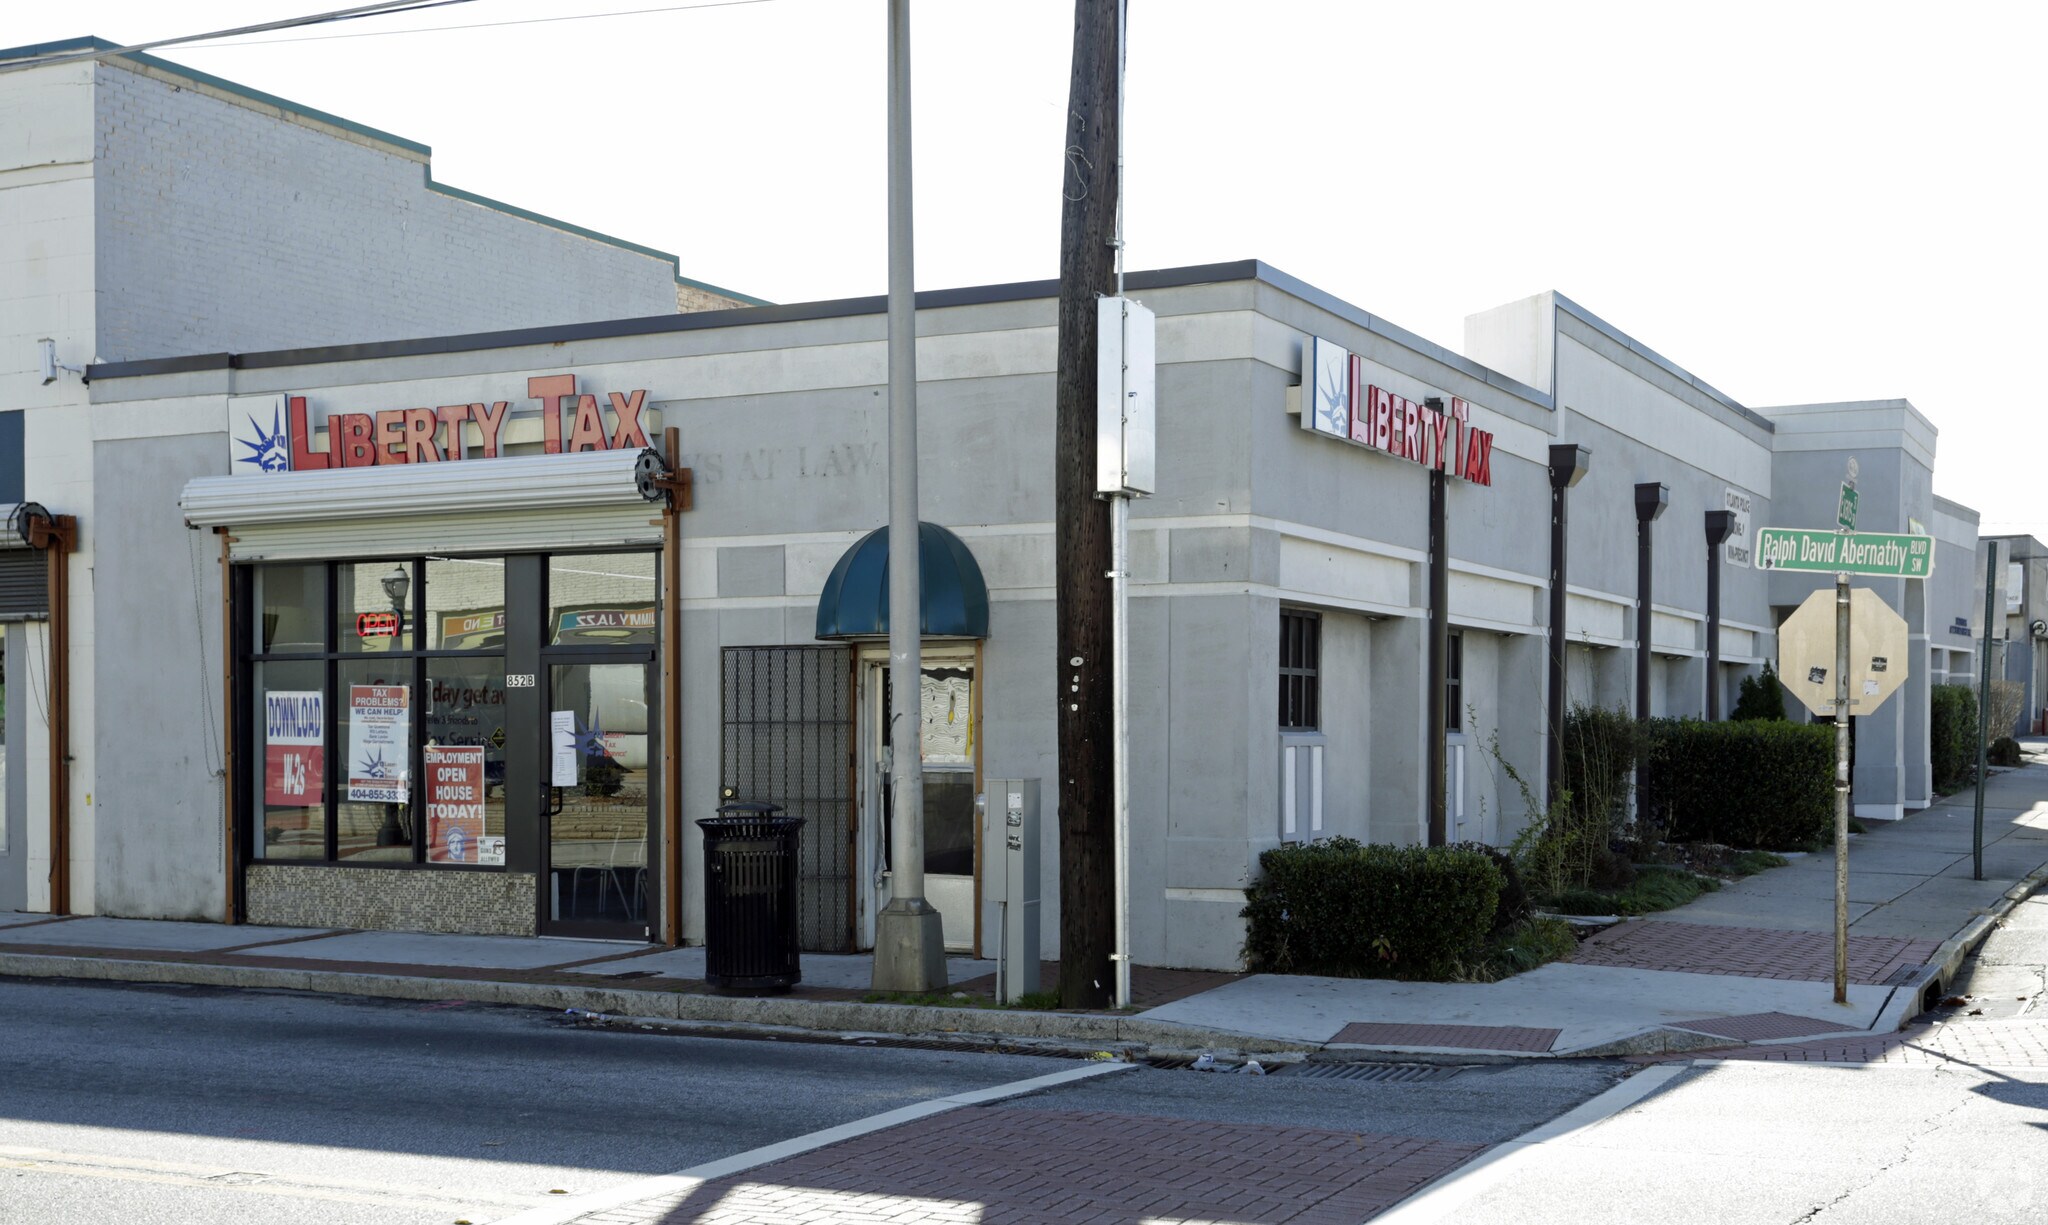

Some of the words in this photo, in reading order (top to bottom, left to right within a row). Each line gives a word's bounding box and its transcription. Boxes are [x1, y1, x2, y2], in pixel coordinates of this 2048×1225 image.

[290, 397, 510, 471] LIBERTY
[528, 374, 648, 455] TAX
[1350, 354, 1449, 470] LIBERTY
[1452, 396, 1494, 487] TAX
[1764, 533, 1797, 567] Ralph
[1801, 535, 1836, 563] David
[1839, 537, 1908, 574] Abernathy
[1910, 540, 1927, 555] BLVD
[1911, 558, 1923, 572] SW
[356, 613, 399, 637] OPEN
[372, 688, 388, 697] TAX
[355, 697, 404, 707] PROBLEMS?
[268, 696, 321, 738] DOWNLOAD
[426, 752, 482, 764] EMPLOYMENT
[283, 753, 305, 795] W-2s
[437, 767, 466, 782] OPEN
[435, 785, 473, 800] HOUSE
[428, 803, 482, 819] TODAY!
